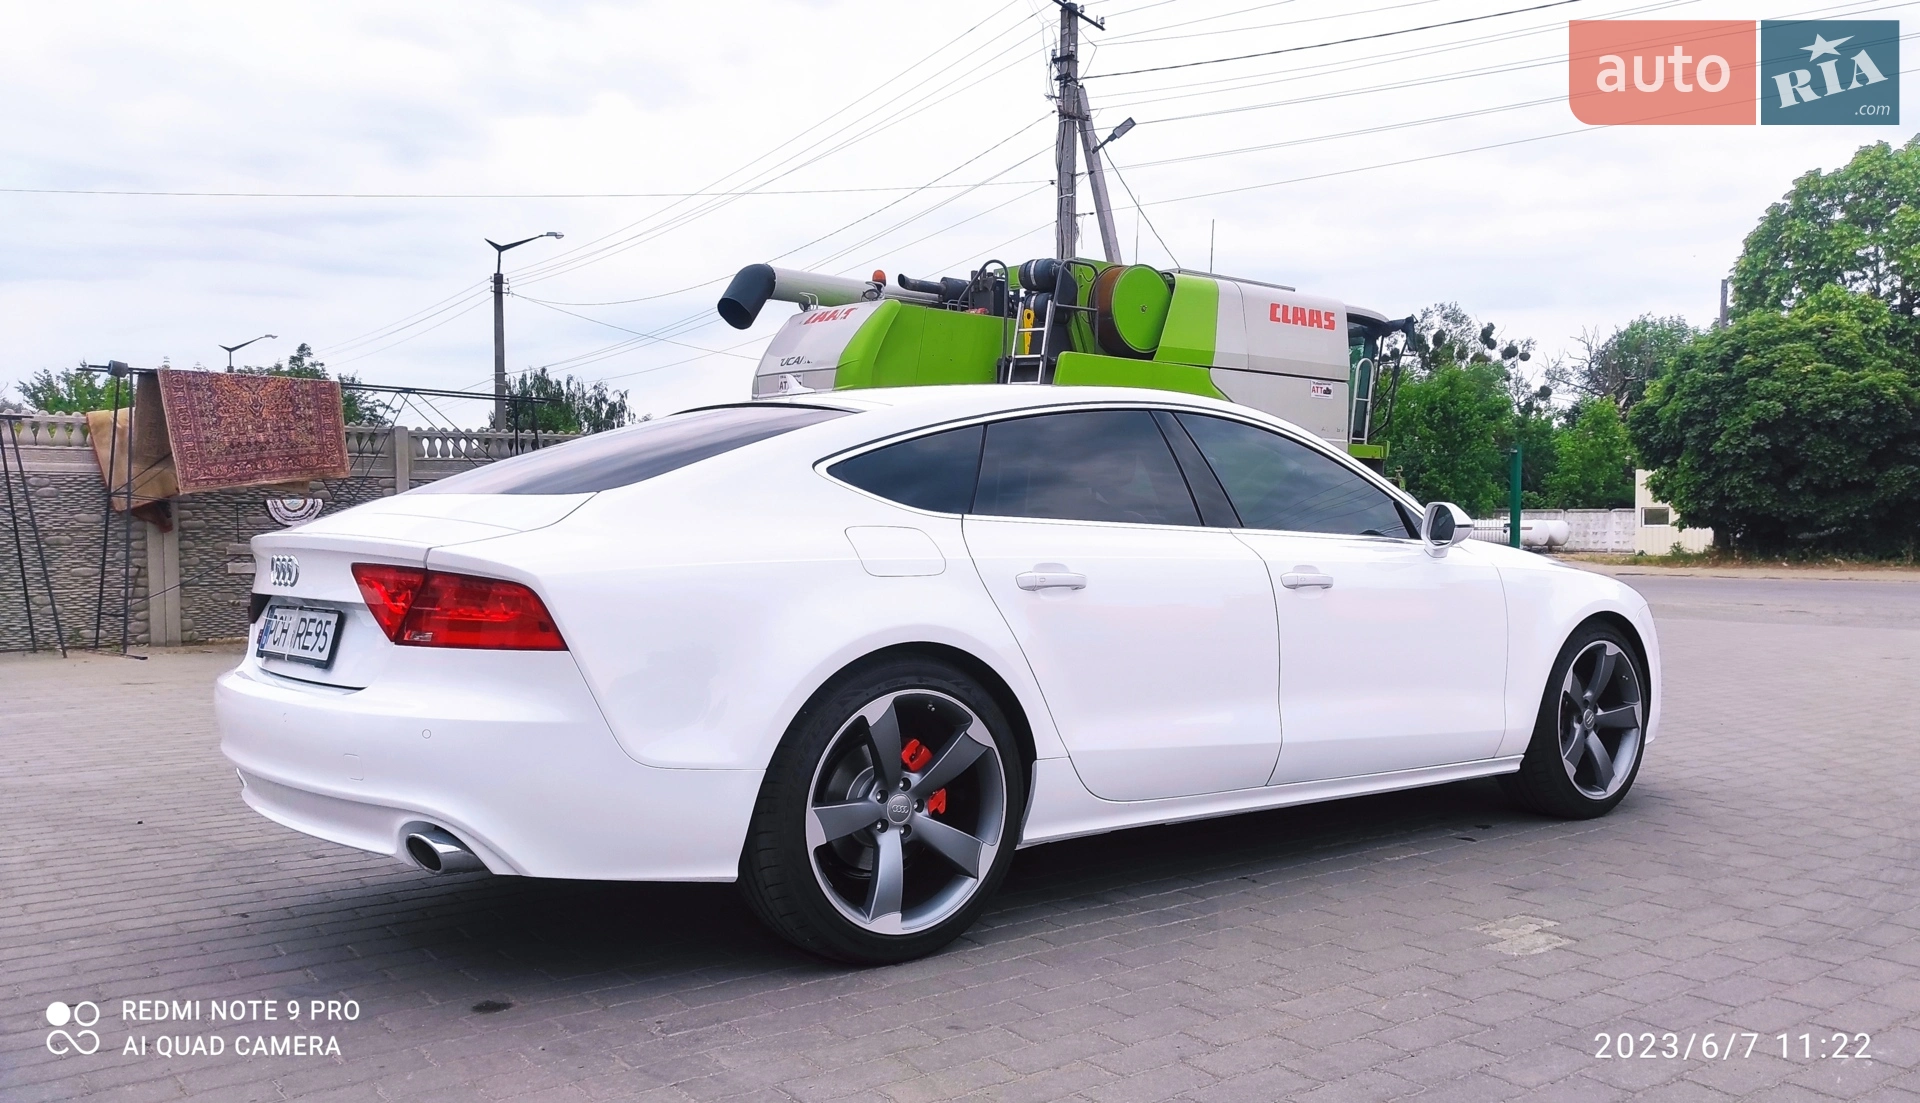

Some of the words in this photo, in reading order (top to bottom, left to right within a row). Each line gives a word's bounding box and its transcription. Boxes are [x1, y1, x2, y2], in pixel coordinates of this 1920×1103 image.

[1269, 302, 1336, 331] CLAAS
[1311, 385, 1324, 394] ATT
[293, 617, 332, 654] RE95
